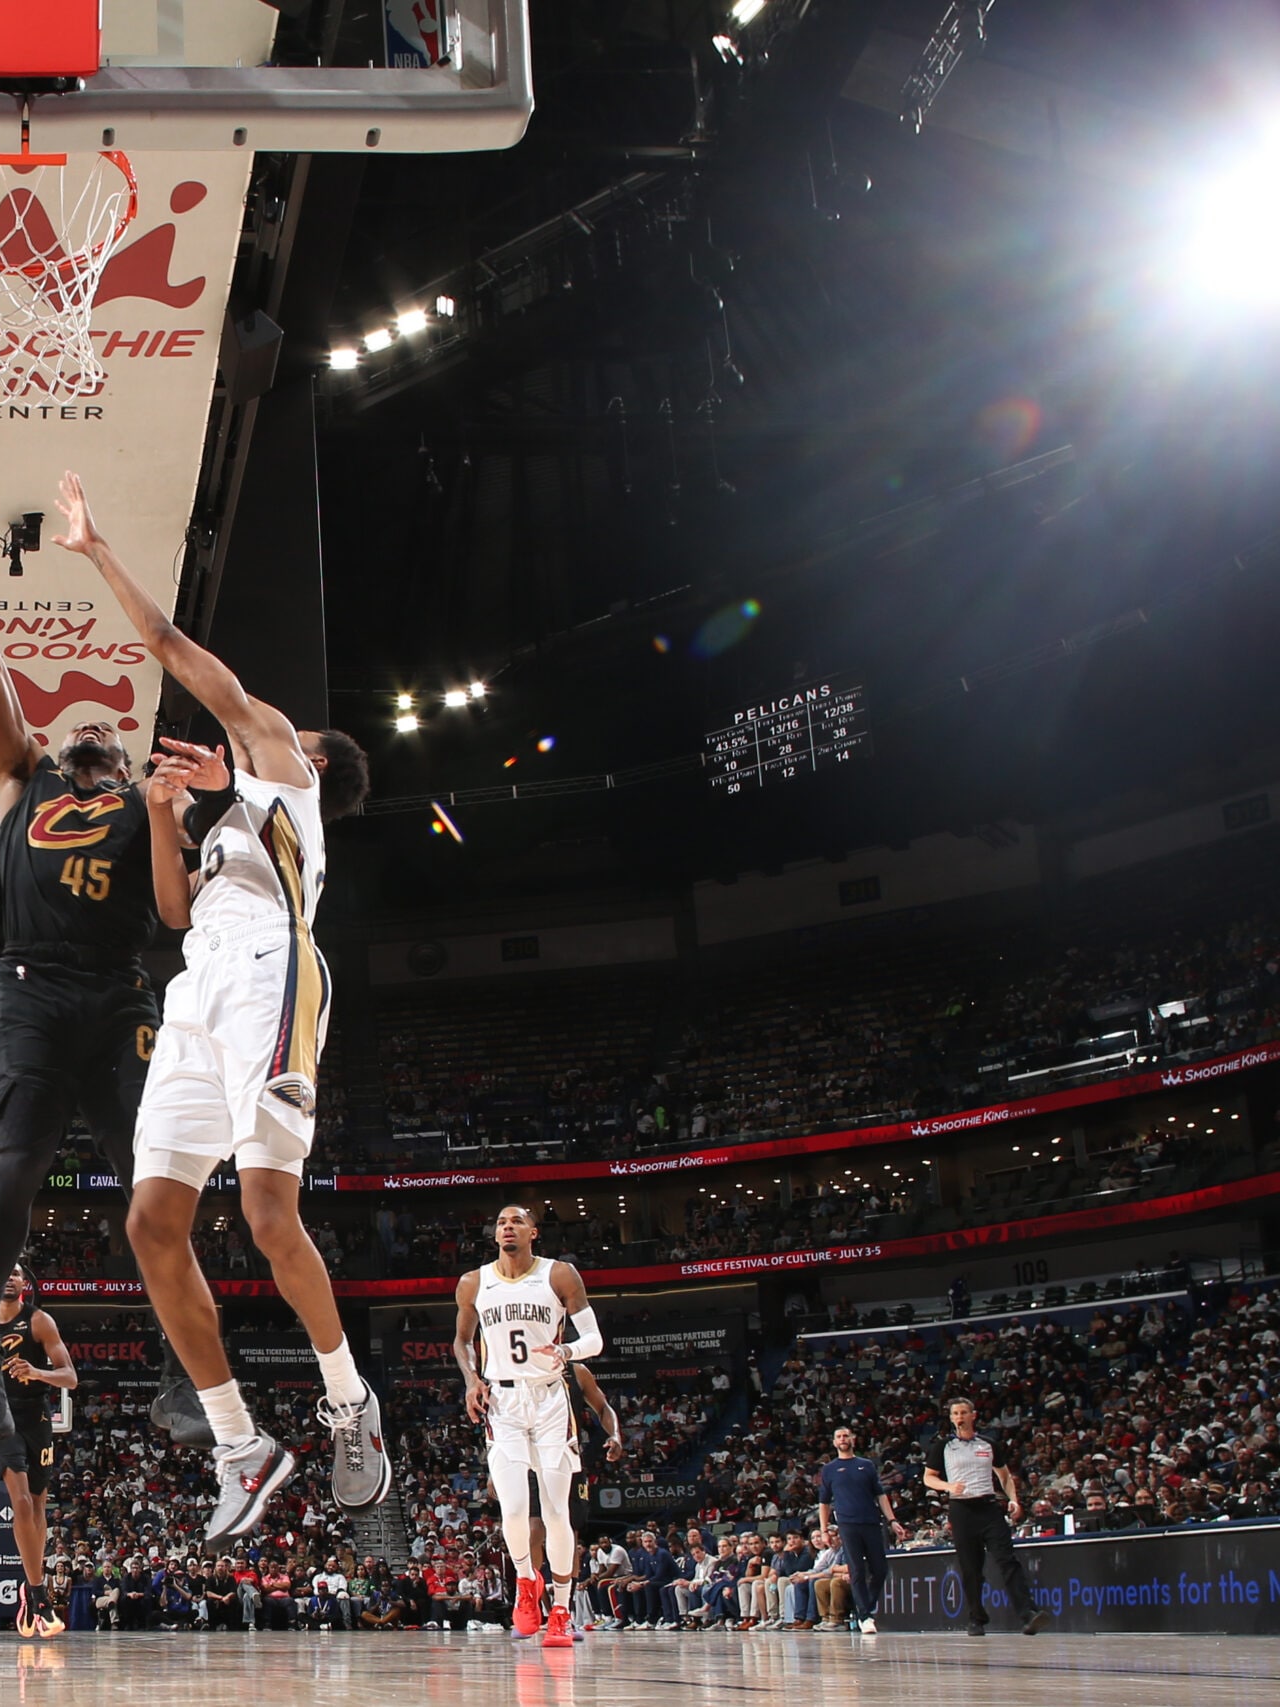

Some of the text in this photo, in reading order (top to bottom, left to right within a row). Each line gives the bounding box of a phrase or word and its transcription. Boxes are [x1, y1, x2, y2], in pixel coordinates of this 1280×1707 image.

[394, 53, 420, 69] NBA
[734, 684, 831, 725] PELICANS
[824, 702, 854, 719] 12/38
[769, 719, 799, 736] 13/16
[833, 727, 847, 740] 38
[715, 735, 748, 752] 43.5%
[778, 744, 792, 756] 28
[835, 750, 849, 762] 14
[724, 761, 737, 772] 10
[781, 767, 795, 779] 12
[727, 783, 741, 794] 50
[60, 856, 112, 900] 45
[1185, 1059, 1240, 1081] SMOOTHIE
[931, 1115, 982, 1133] SMOOTHIE
[629, 1160, 678, 1174] SMOOTHIE
[48, 1175, 73, 1187] 102
[90, 1176, 122, 1187] CAVAL
[402, 1177, 450, 1187] SMOOTHIE
[681, 1262, 723, 1275] ESSENCE
[724, 1258, 769, 1271] FESTIVAL
[771, 1255, 784, 1265] OF
[786, 1251, 832, 1264] CULTURE
[840, 1248, 863, 1259] JULY
[865, 1246, 881, 1256] 3-5
[1012, 1259, 1049, 1286] 109
[42, 1283, 55, 1291] OF
[57, 1283, 98, 1291] CULTURE
[104, 1283, 126, 1291] JULY
[127, 1283, 142, 1291] 3-5
[482, 1303, 551, 1327] NEW ORLEANS
[613, 1329, 727, 1346] OFFICIAL TICKETING PARTNER OF
[509, 1329, 528, 1364] 5
[620, 1346, 633, 1354] THE
[634, 1345, 651, 1353] NEW
[624, 1485, 696, 1499] CAESARS
[870, 1577, 936, 1615] HIFT
[946, 1580, 956, 1608] 4
[1069, 1577, 1171, 1616] Payments
[1178, 1571, 1213, 1604] for
[1219, 1570, 1261, 1604] the
